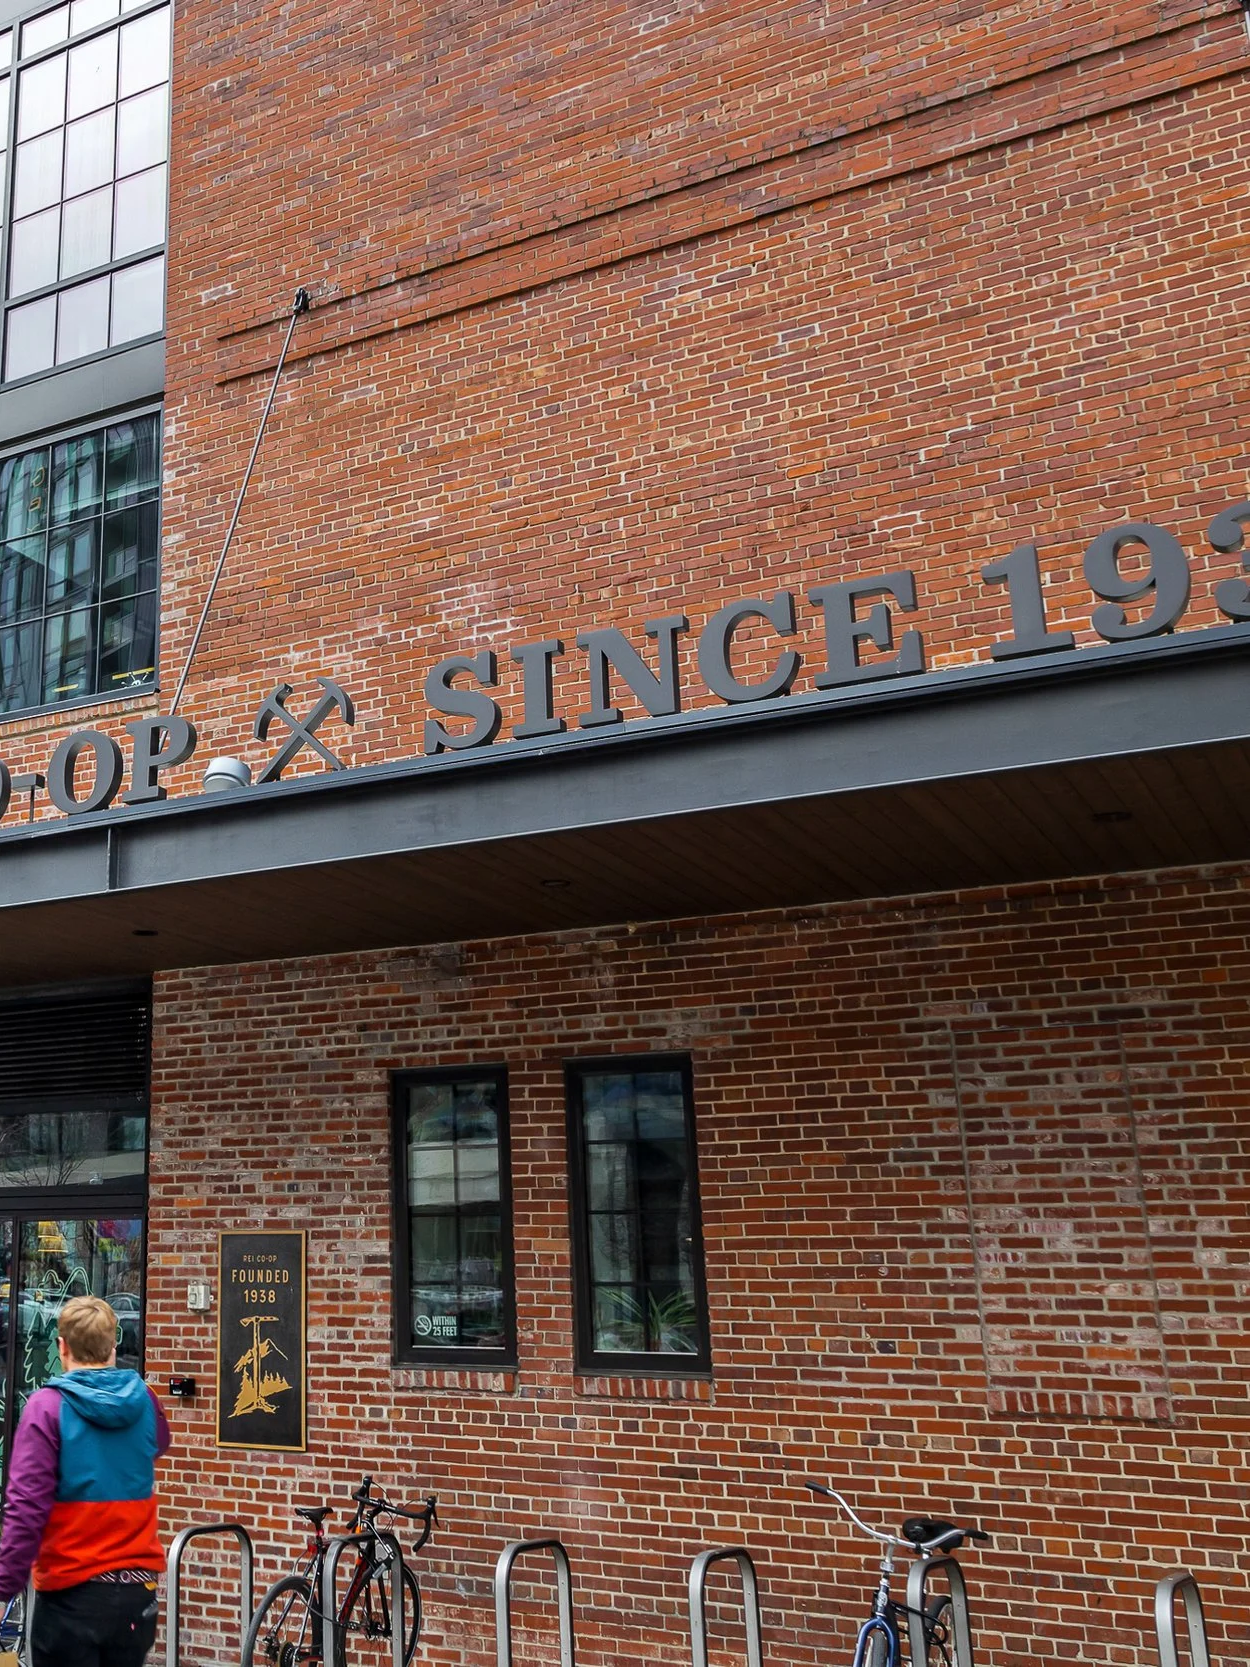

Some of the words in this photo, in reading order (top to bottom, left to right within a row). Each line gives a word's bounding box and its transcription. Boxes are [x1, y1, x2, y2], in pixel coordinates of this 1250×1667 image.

[424, 569, 926, 755] SINCE
[232, 1269, 289, 1283] FOUNDED
[244, 1289, 276, 1303] 1938
[432, 1316, 457, 1325] WITHIN
[432, 1326, 441, 1336] 25
[442, 1326, 457, 1336] FEET
